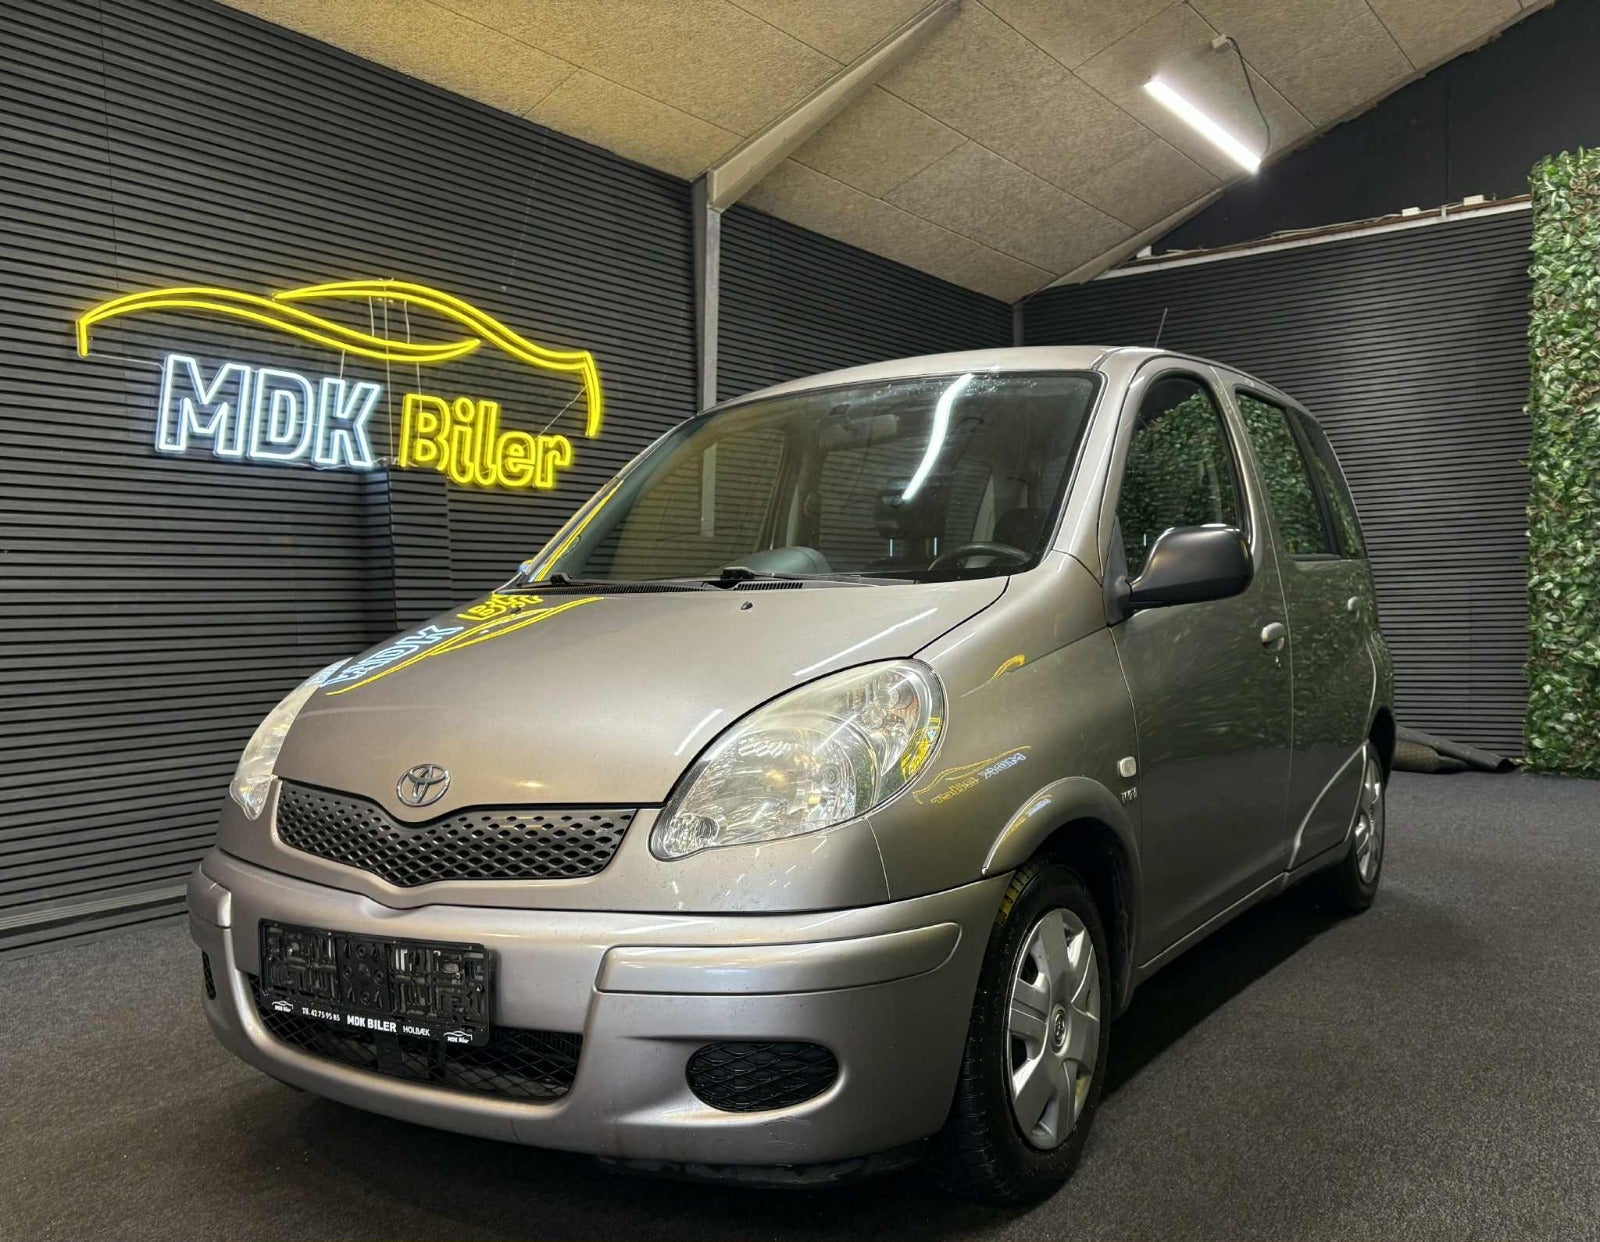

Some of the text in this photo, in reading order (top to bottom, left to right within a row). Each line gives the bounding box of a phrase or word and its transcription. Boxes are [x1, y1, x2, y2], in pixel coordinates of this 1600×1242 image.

[155, 353, 574, 490] MDK Biler
[346, 1014, 397, 1033] MDK BILER
